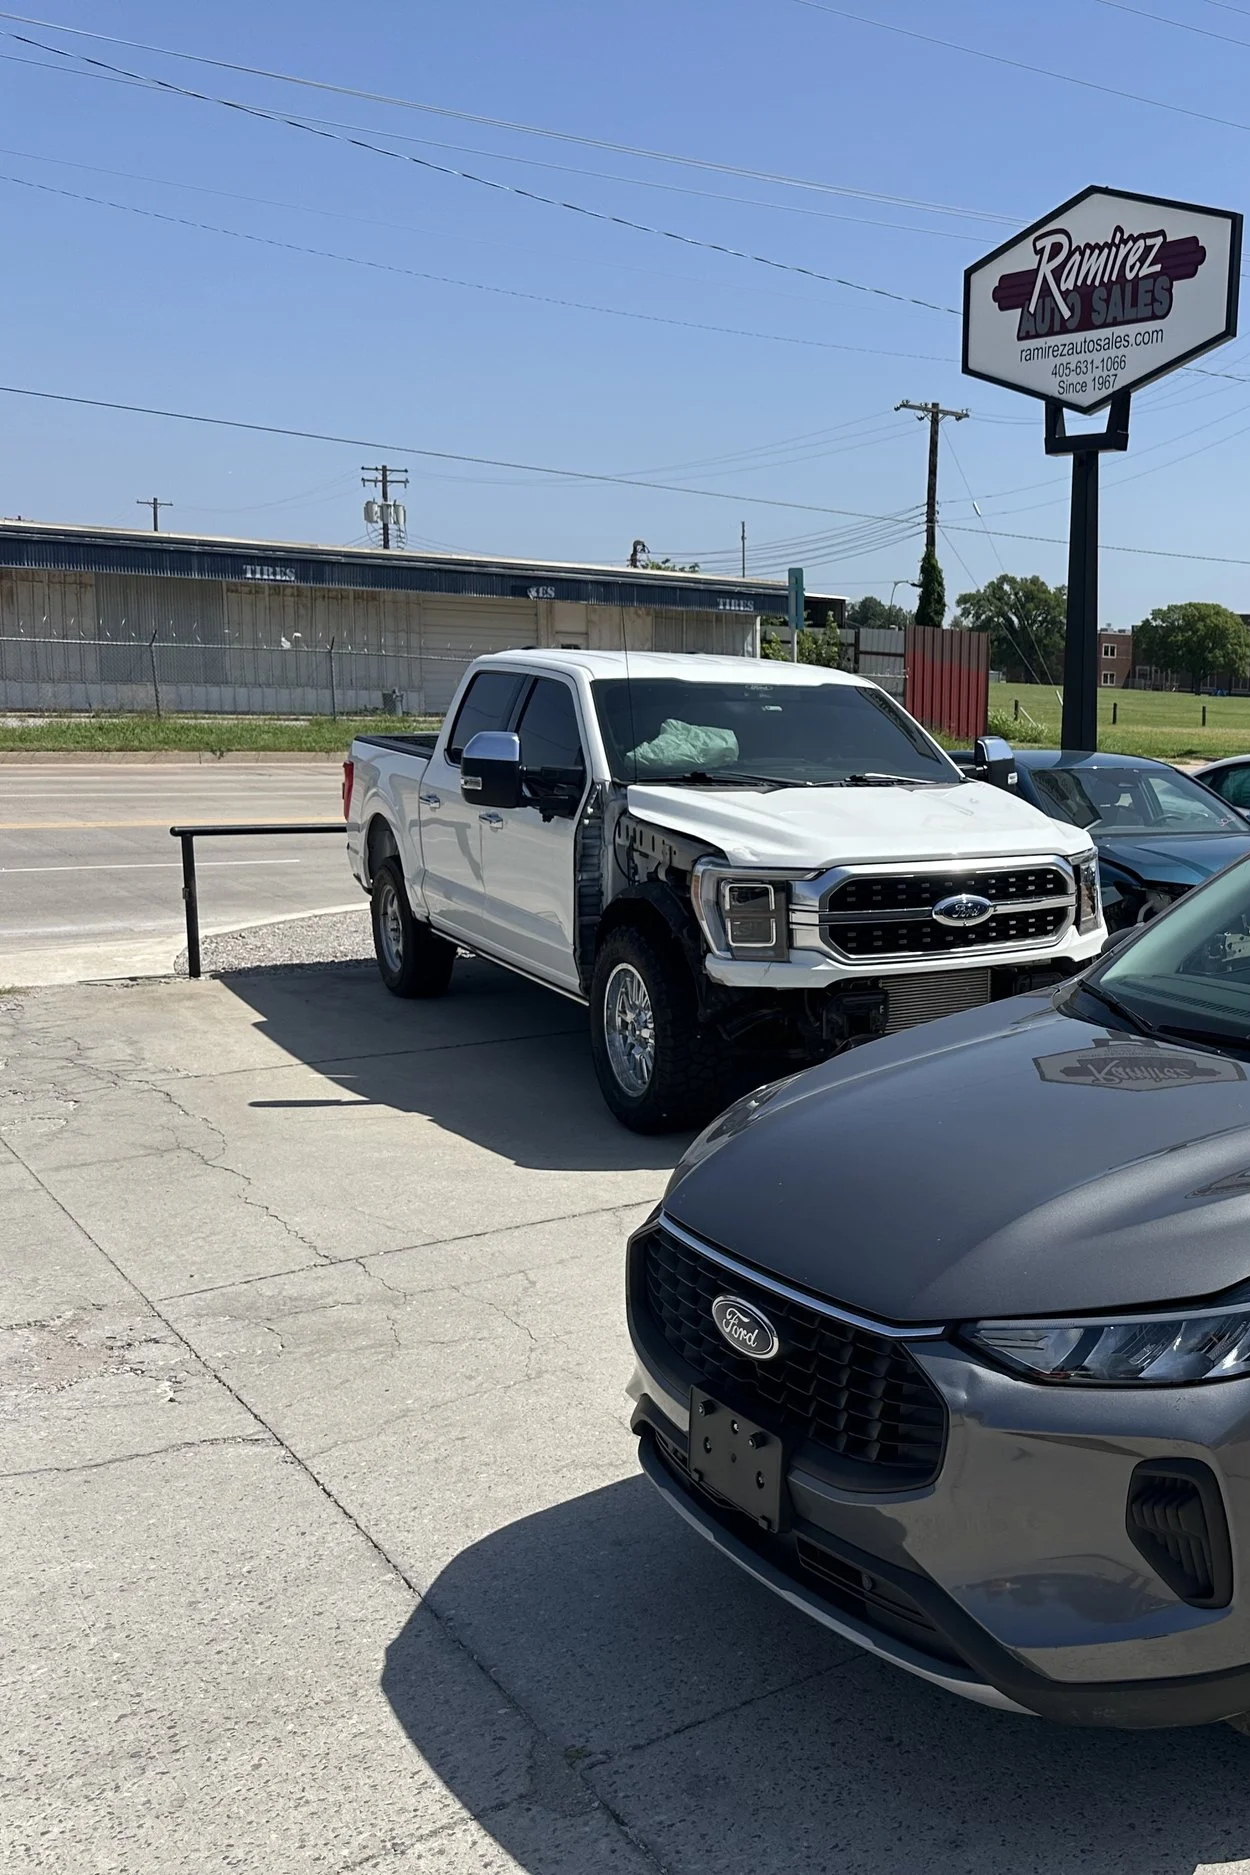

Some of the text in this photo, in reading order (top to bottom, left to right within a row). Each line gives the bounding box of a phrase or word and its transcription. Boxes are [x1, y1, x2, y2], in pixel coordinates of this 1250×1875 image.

[1028, 230, 1164, 320] Ramirez
[1019, 275, 1171, 337] AUTO SALES
[1020, 328, 1164, 362] ramirezautosales.com
[1051, 354, 1127, 378] 405-631-1066
[1057, 373, 1118, 395] Since 1967
[243, 564, 296, 581] TIRES
[717, 597, 755, 611] TIRES
[951, 902, 981, 918] Ford
[722, 1307, 760, 1347] Ford
